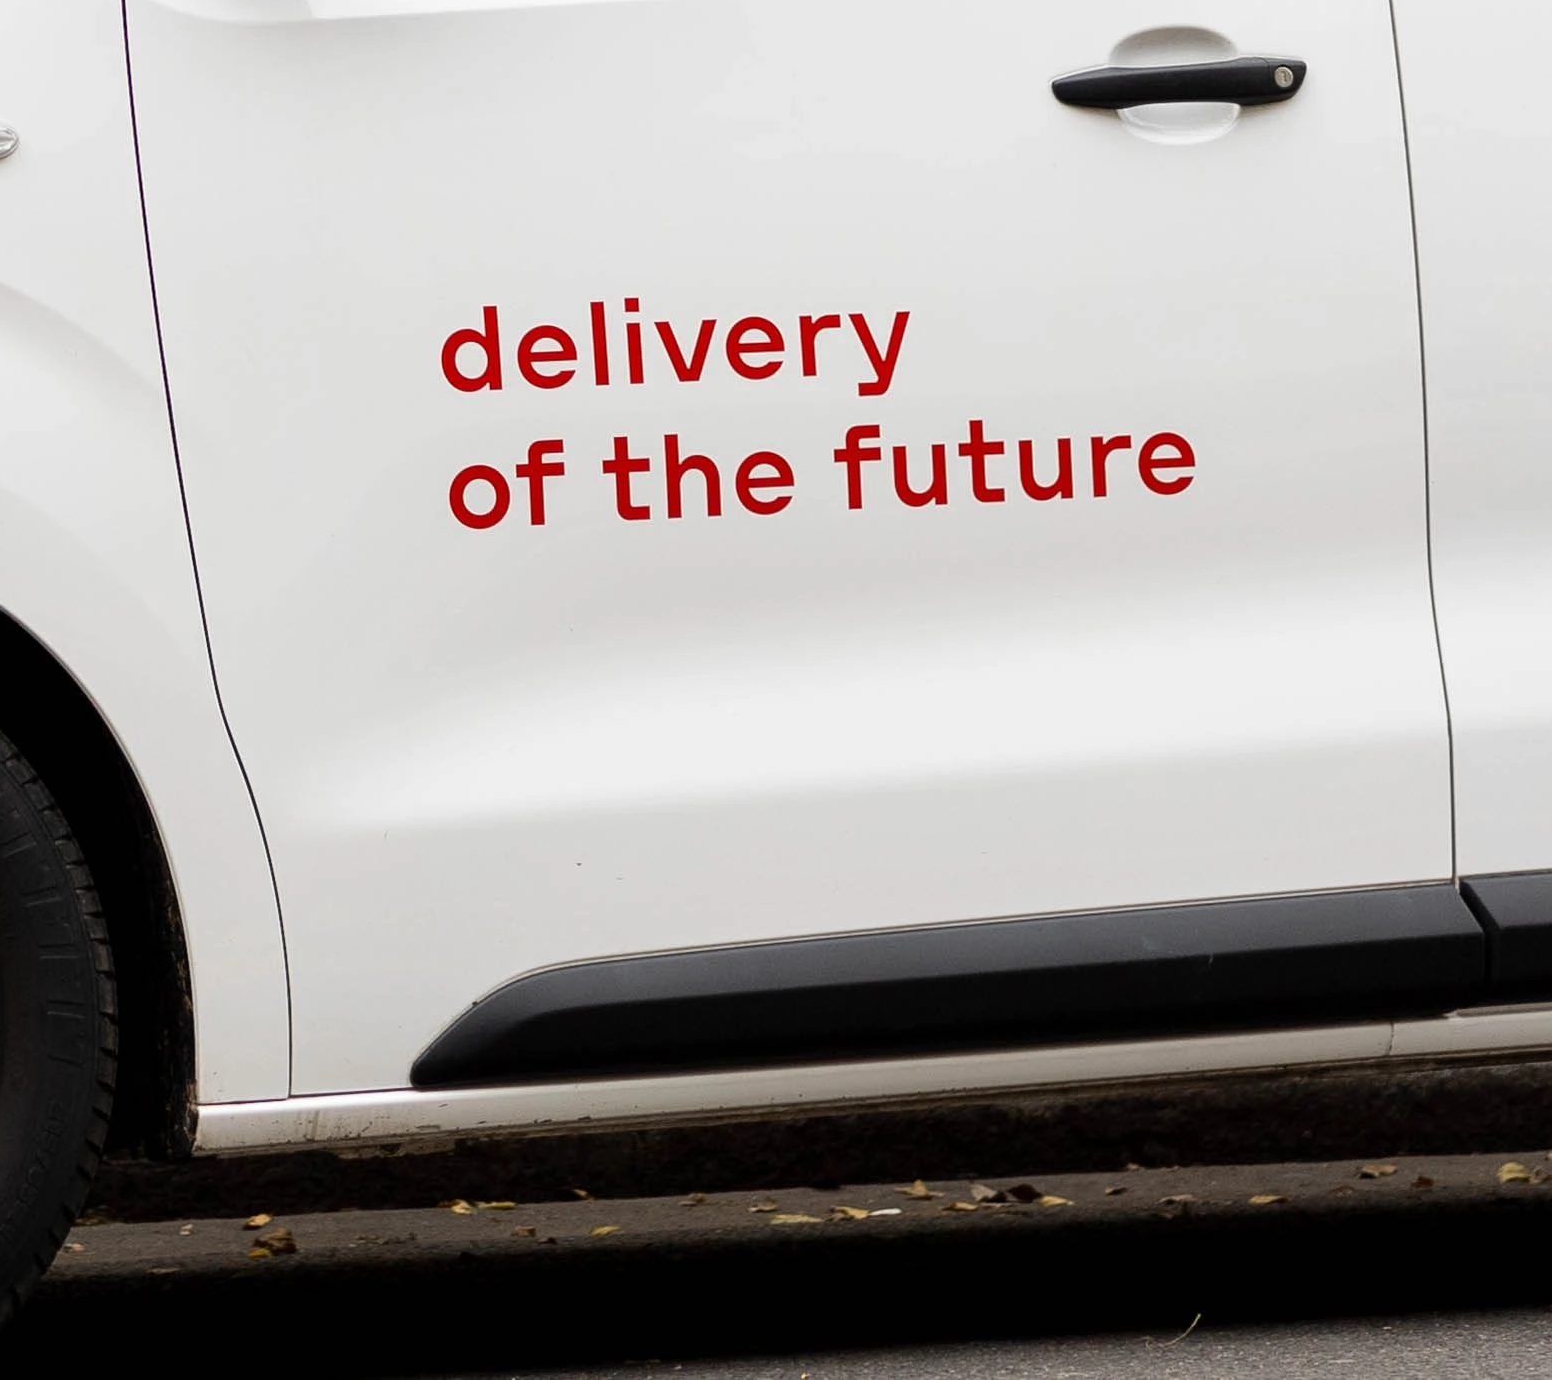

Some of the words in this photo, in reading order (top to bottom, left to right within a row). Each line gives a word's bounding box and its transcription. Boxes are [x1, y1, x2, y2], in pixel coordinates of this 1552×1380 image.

[440, 297, 910, 397] delivery
[448, 438, 566, 530] of
[602, 433, 795, 521] the
[833, 419, 1196, 510] future
